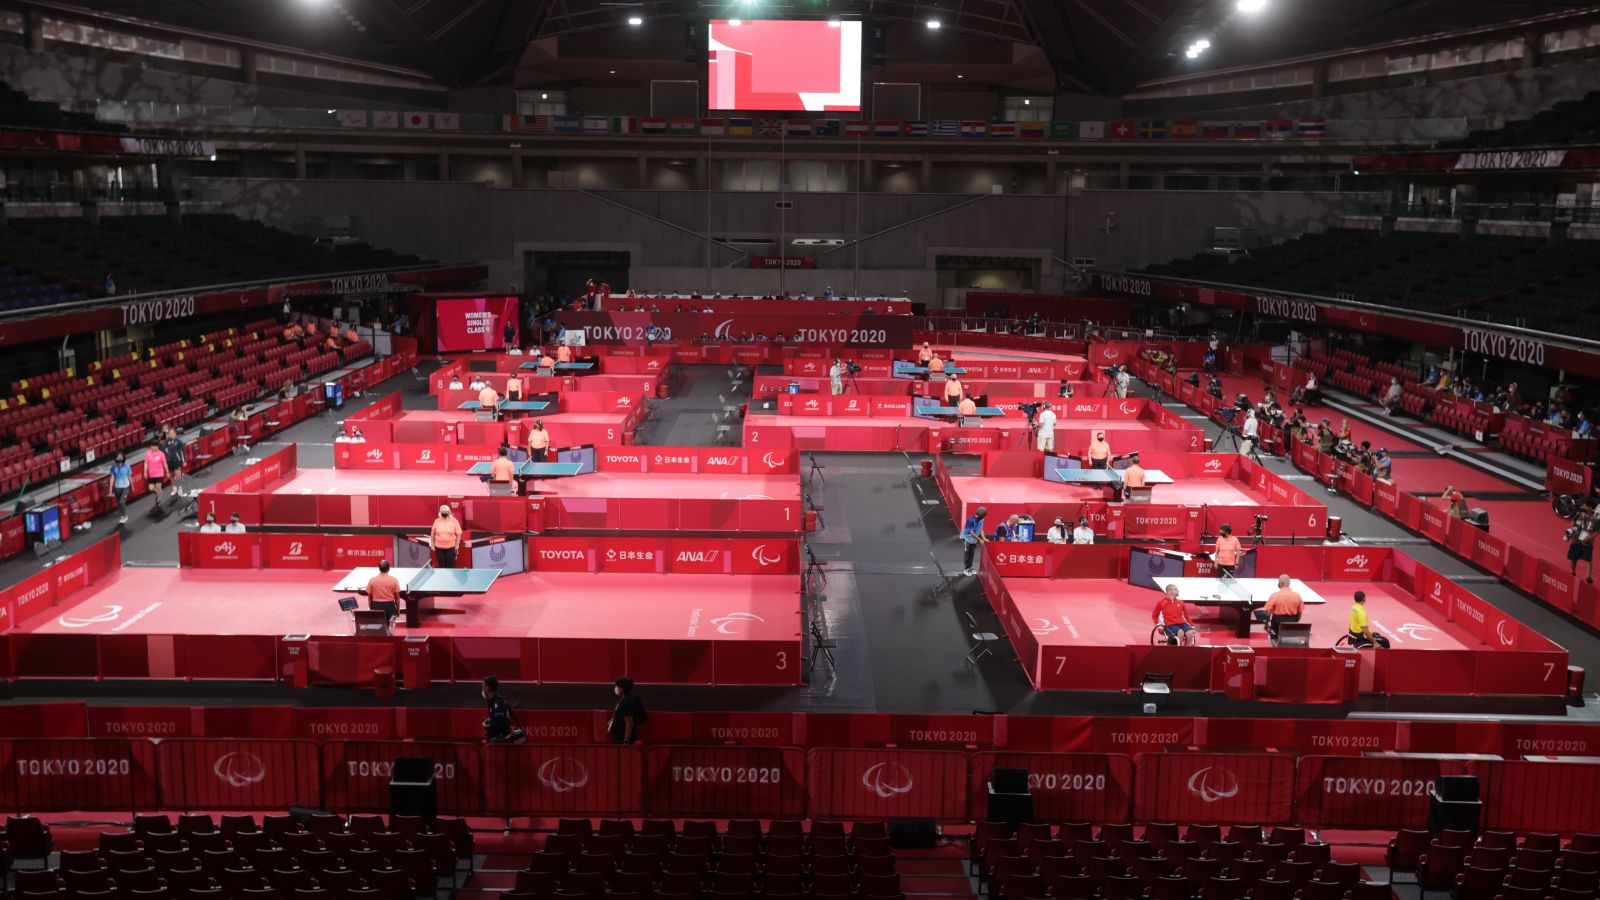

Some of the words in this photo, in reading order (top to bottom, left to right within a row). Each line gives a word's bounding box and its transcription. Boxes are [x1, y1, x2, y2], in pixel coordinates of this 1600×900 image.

[765, 258, 783, 266] TOKY
[331, 277, 361, 294] TOKYO
[362, 273, 388, 292] 2020
[1100, 275, 1128, 292] TOKYO
[1130, 279, 1151, 296] 2020
[121, 301, 164, 325] TOKYO
[166, 296, 195, 320] 2020
[1256, 297, 1290, 319] TOKYO
[1291, 300, 1317, 322] 2020
[584, 326, 632, 340] TOKYO
[636, 326, 671, 340] 220
[798, 328, 847, 343] TOKYO
[850, 328, 887, 343] 2020
[1463, 328, 1507, 357] TOKYO
[1509, 337, 1544, 366] 2020
[1074, 404, 1093, 412] ANA
[607, 429, 614, 440] 5
[752, 431, 759, 443] 2
[1190, 436, 1197, 447] 2
[606, 455, 639, 463] TOYOTA
[664, 456, 690, 464] 日本生命
[706, 456, 728, 465] ANA
[1553, 466, 1570, 480] TOKYO
[1570, 471, 1583, 484] 2020
[784, 507, 790, 520] 1
[1090, 513, 1106, 521] TOK
[1136, 517, 1159, 525] TOKYO
[1160, 517, 1177, 525] 2020
[1308, 513, 1317, 527] 6
[540, 550, 584, 560] TOYOTA
[619, 550, 653, 560] 日本生命
[676, 550, 705, 562] ANA
[1009, 554, 1044, 564] 日本生命
[18, 590, 36, 606] TOKYO
[36, 582, 49, 597] 2020
[1457, 598, 1472, 616] TOKYO
[1472, 607, 1485, 624] 2020
[776, 651, 787, 670] 3
[1055, 656, 1067, 675] 7
[1543, 662, 1555, 682] 7
[106, 722, 145, 733] TOKYO
[147, 722, 176, 733] 2020
[310, 723, 348, 734] TOKYO
[351, 723, 379, 734] 2020
[550, 726, 578, 737] 2020
[711, 727, 749, 739] TOKYO
[751, 727, 779, 738] 2020
[910, 730, 947, 741] TOKYO
[949, 730, 977, 742] 2020
[1111, 732, 1149, 744] TOKYO
[1151, 732, 1179, 743] 2020
[1311, 736, 1349, 747] TOKYO
[1351, 736, 1380, 748] 2020
[1517, 739, 1554, 751] TOKYO
[1556, 741, 1586, 752] 2020
[17, 759, 80, 776] TOKYO
[85, 759, 130, 776] 2020
[348, 760, 395, 778] TOKY
[435, 763, 455, 779] 20
[672, 766, 732, 782] TOKYO
[736, 767, 781, 783] 2020
[1060, 774, 1106, 791] 2020
[1324, 777, 1386, 795] TOKYO
[1390, 779, 1436, 797] 2020
